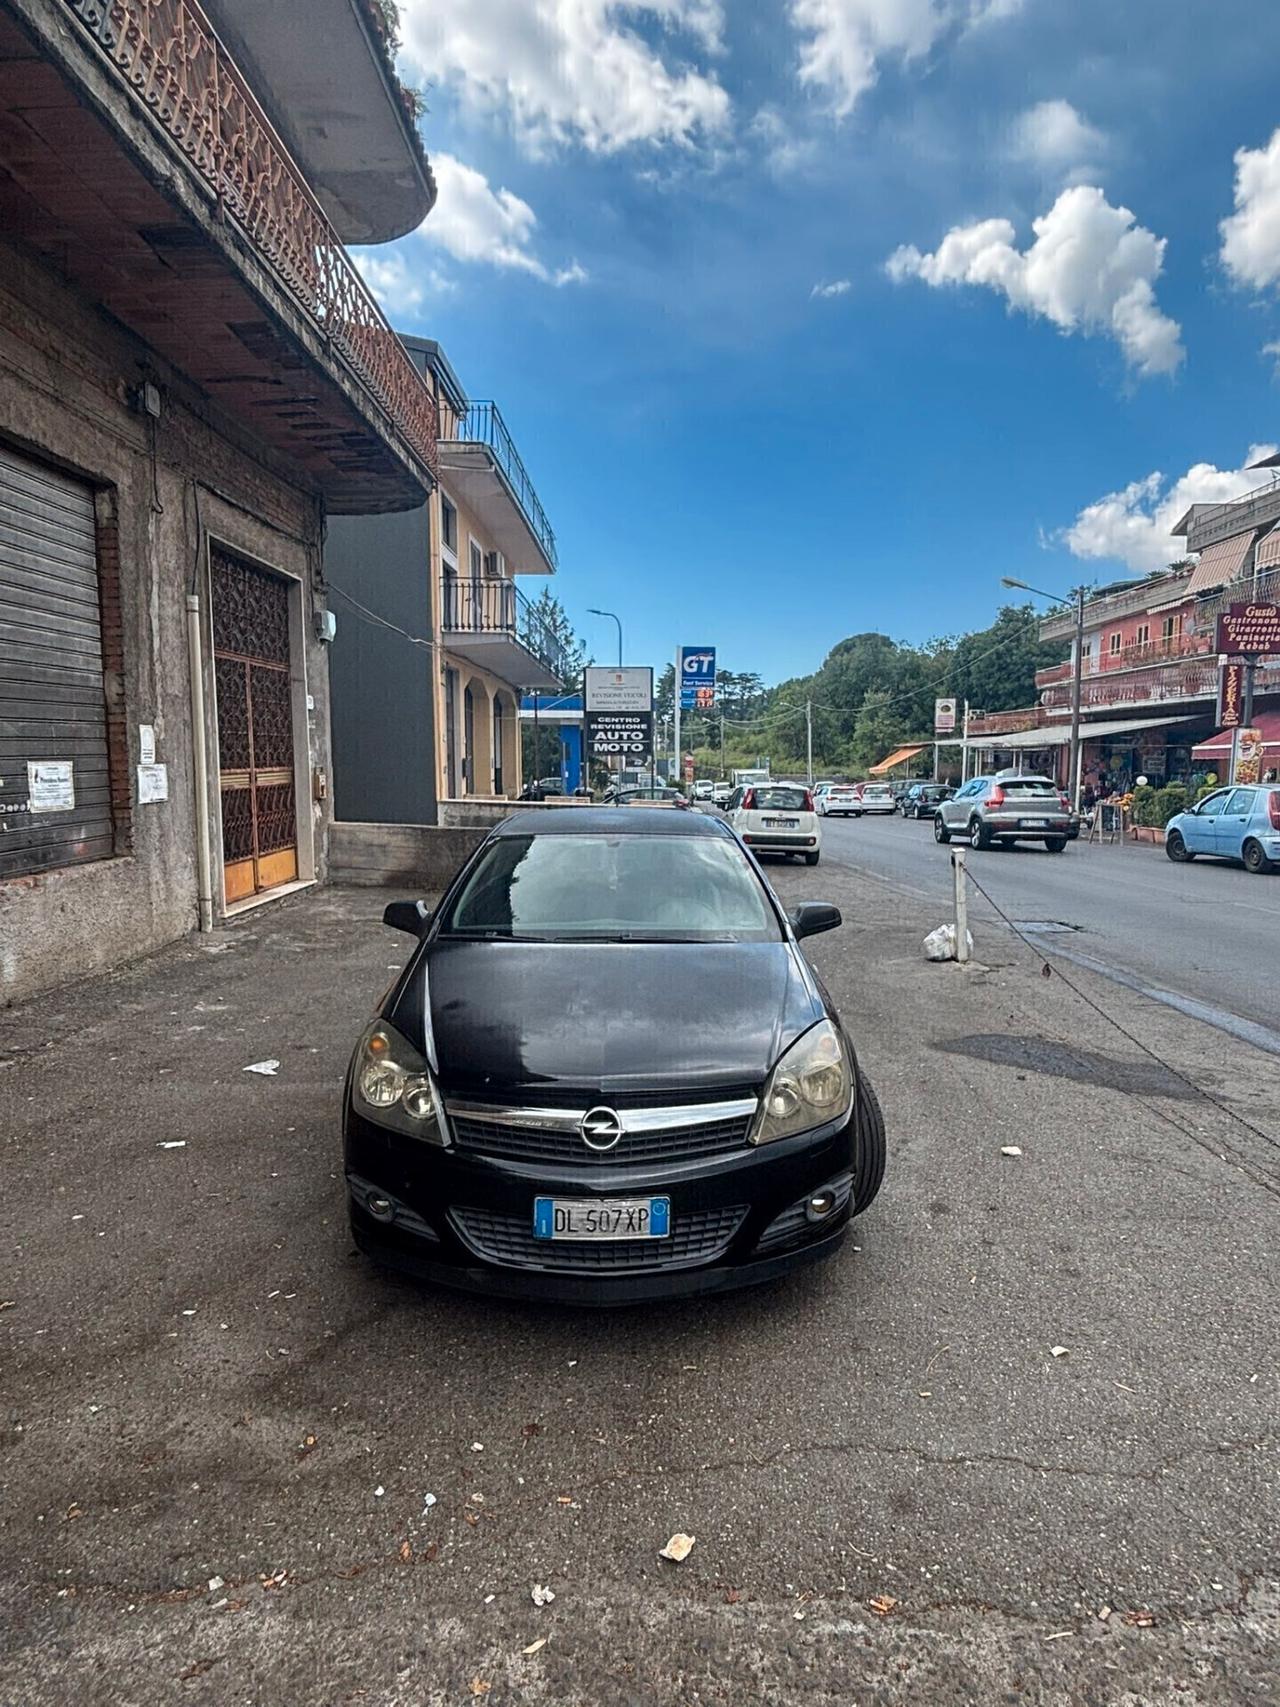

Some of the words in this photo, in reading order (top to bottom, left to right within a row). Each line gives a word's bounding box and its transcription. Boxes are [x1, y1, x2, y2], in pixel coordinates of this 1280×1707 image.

[1222, 615, 1280, 624] Gastronom
[1238, 641, 1270, 650] Kebab
[683, 654, 714, 673] GT
[1225, 665, 1238, 712] PIZZERIA
[594, 731, 644, 740] AUTO
[593, 743, 644, 752] MOTO
[555, 1208, 579, 1233] DL
[586, 1208, 649, 1233] 507XP
